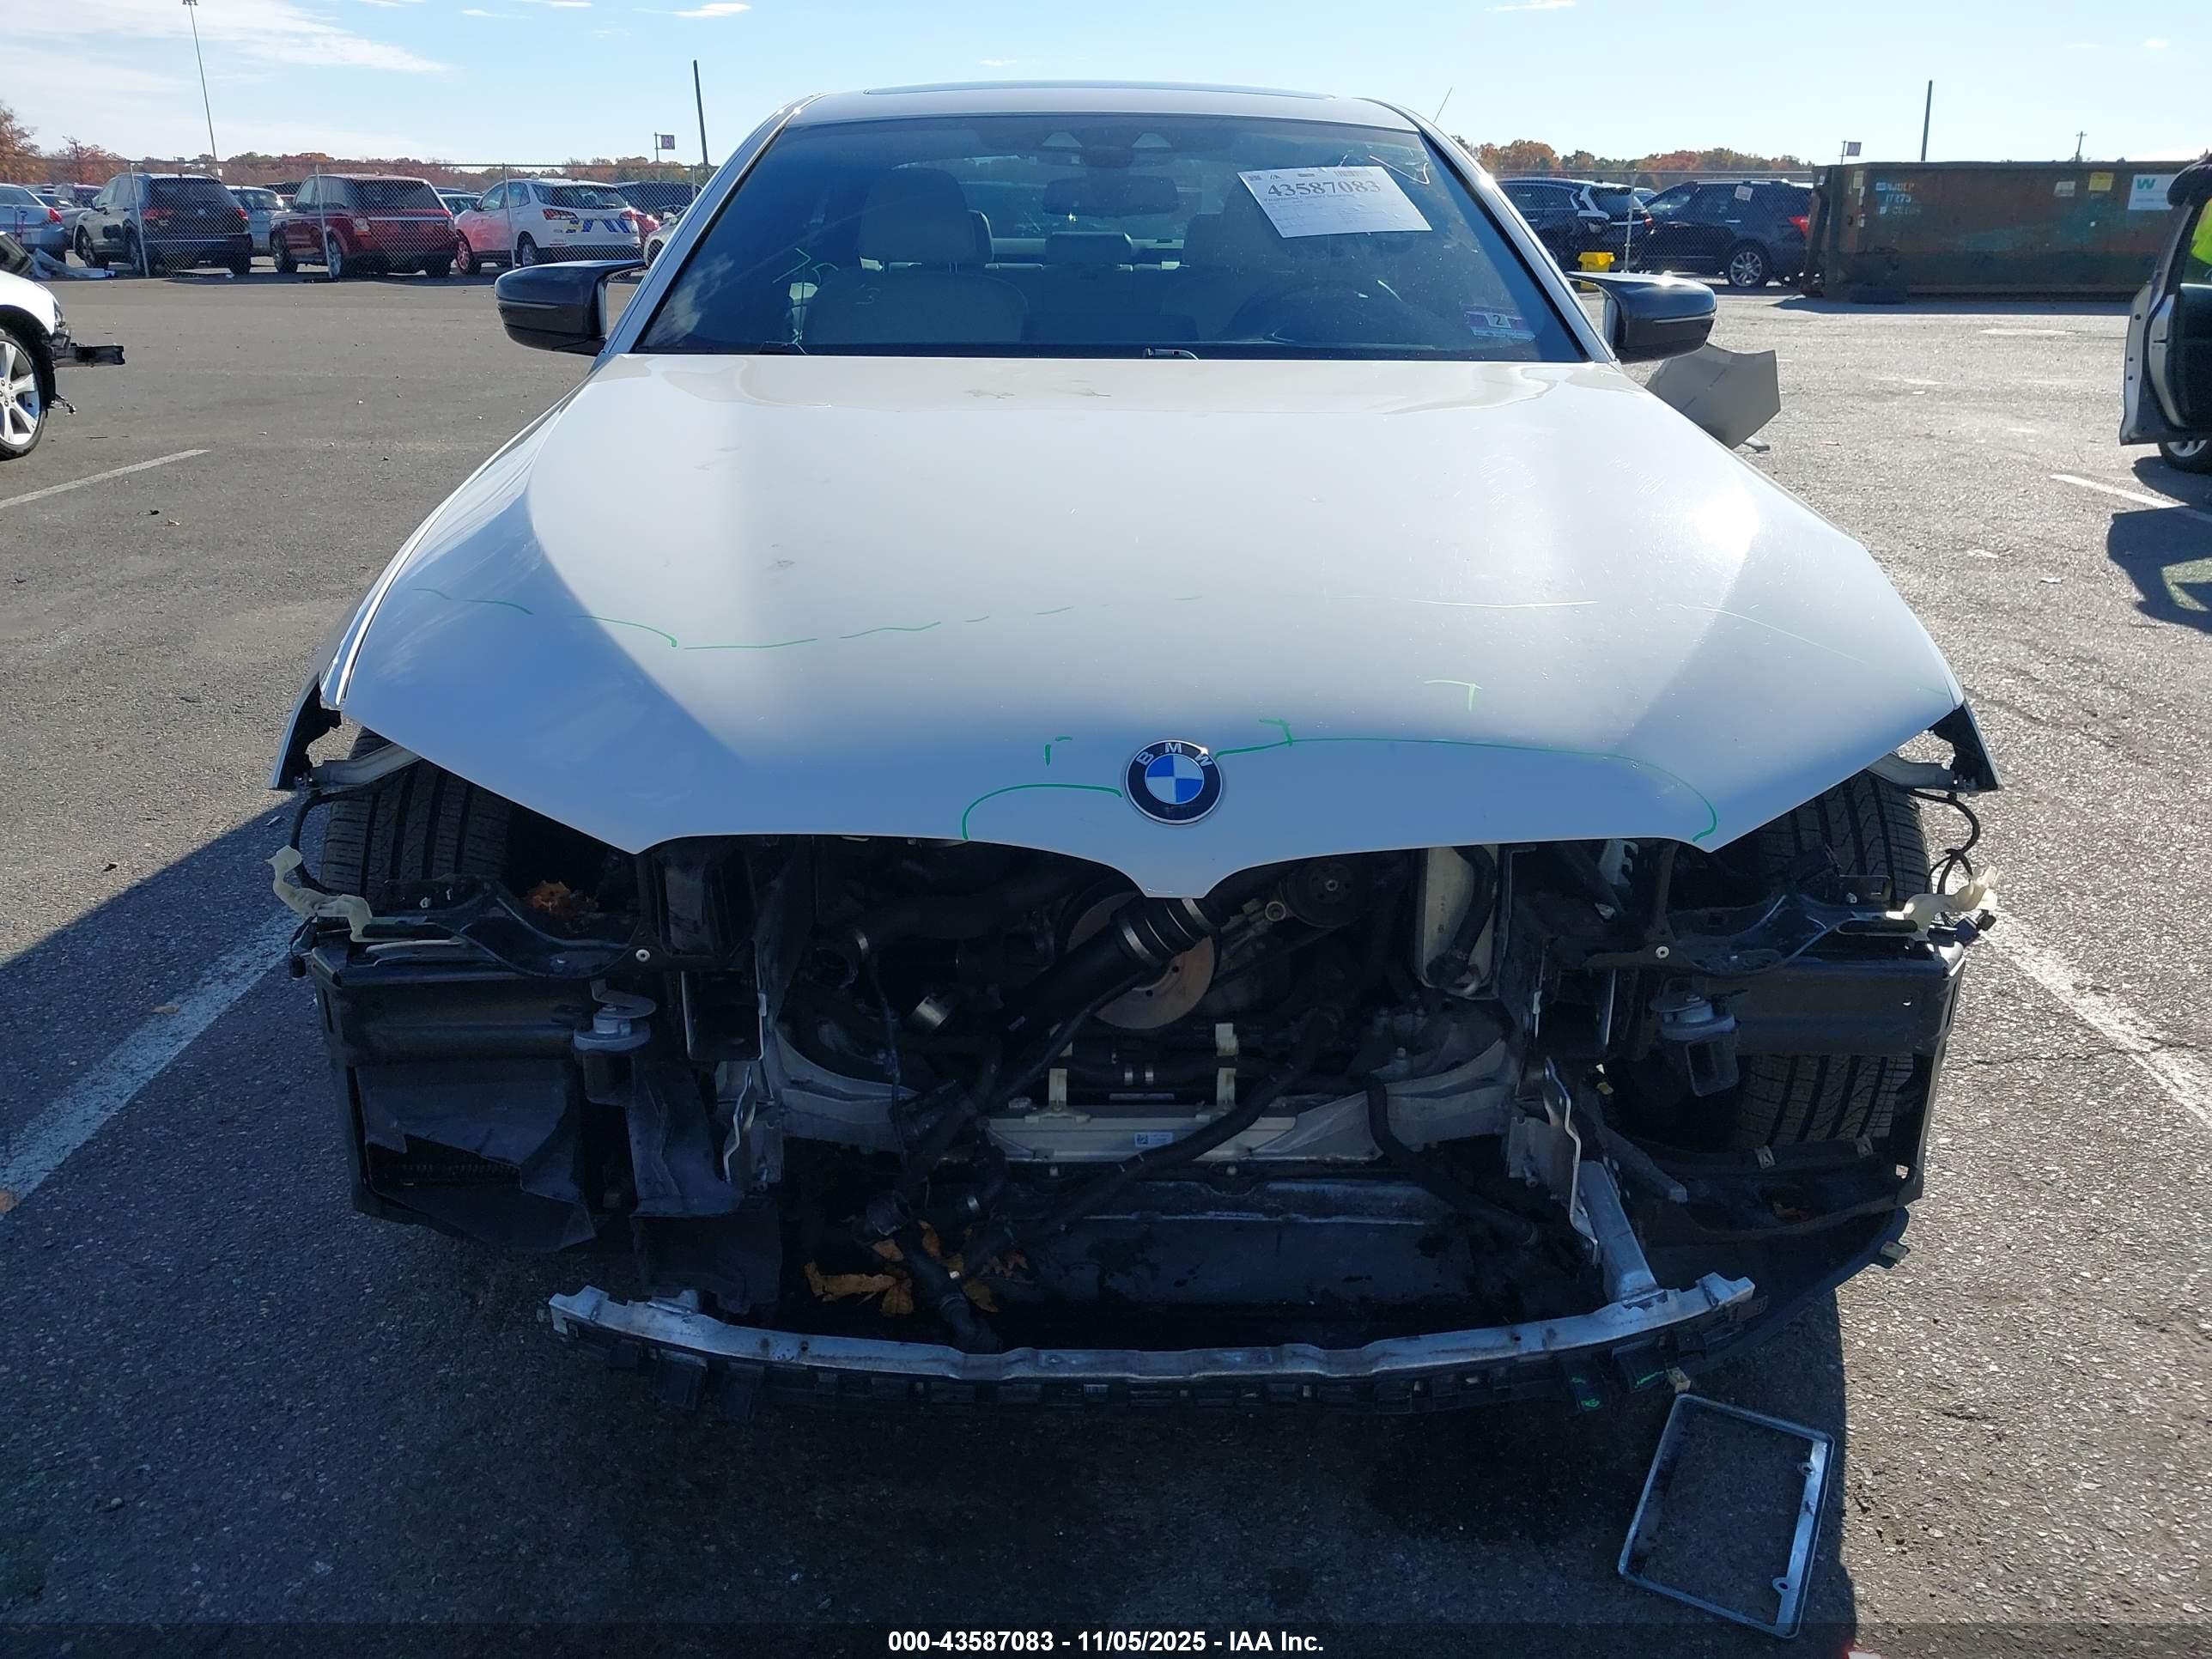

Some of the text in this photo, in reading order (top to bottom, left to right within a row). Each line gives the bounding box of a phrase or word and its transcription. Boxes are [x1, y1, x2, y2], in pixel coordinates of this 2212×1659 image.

[1267, 179, 1382, 197] 43587083
[2136, 179, 2156, 189] W
[1492, 314, 1504, 326] 2
[1135, 742, 1212, 767] BMW
